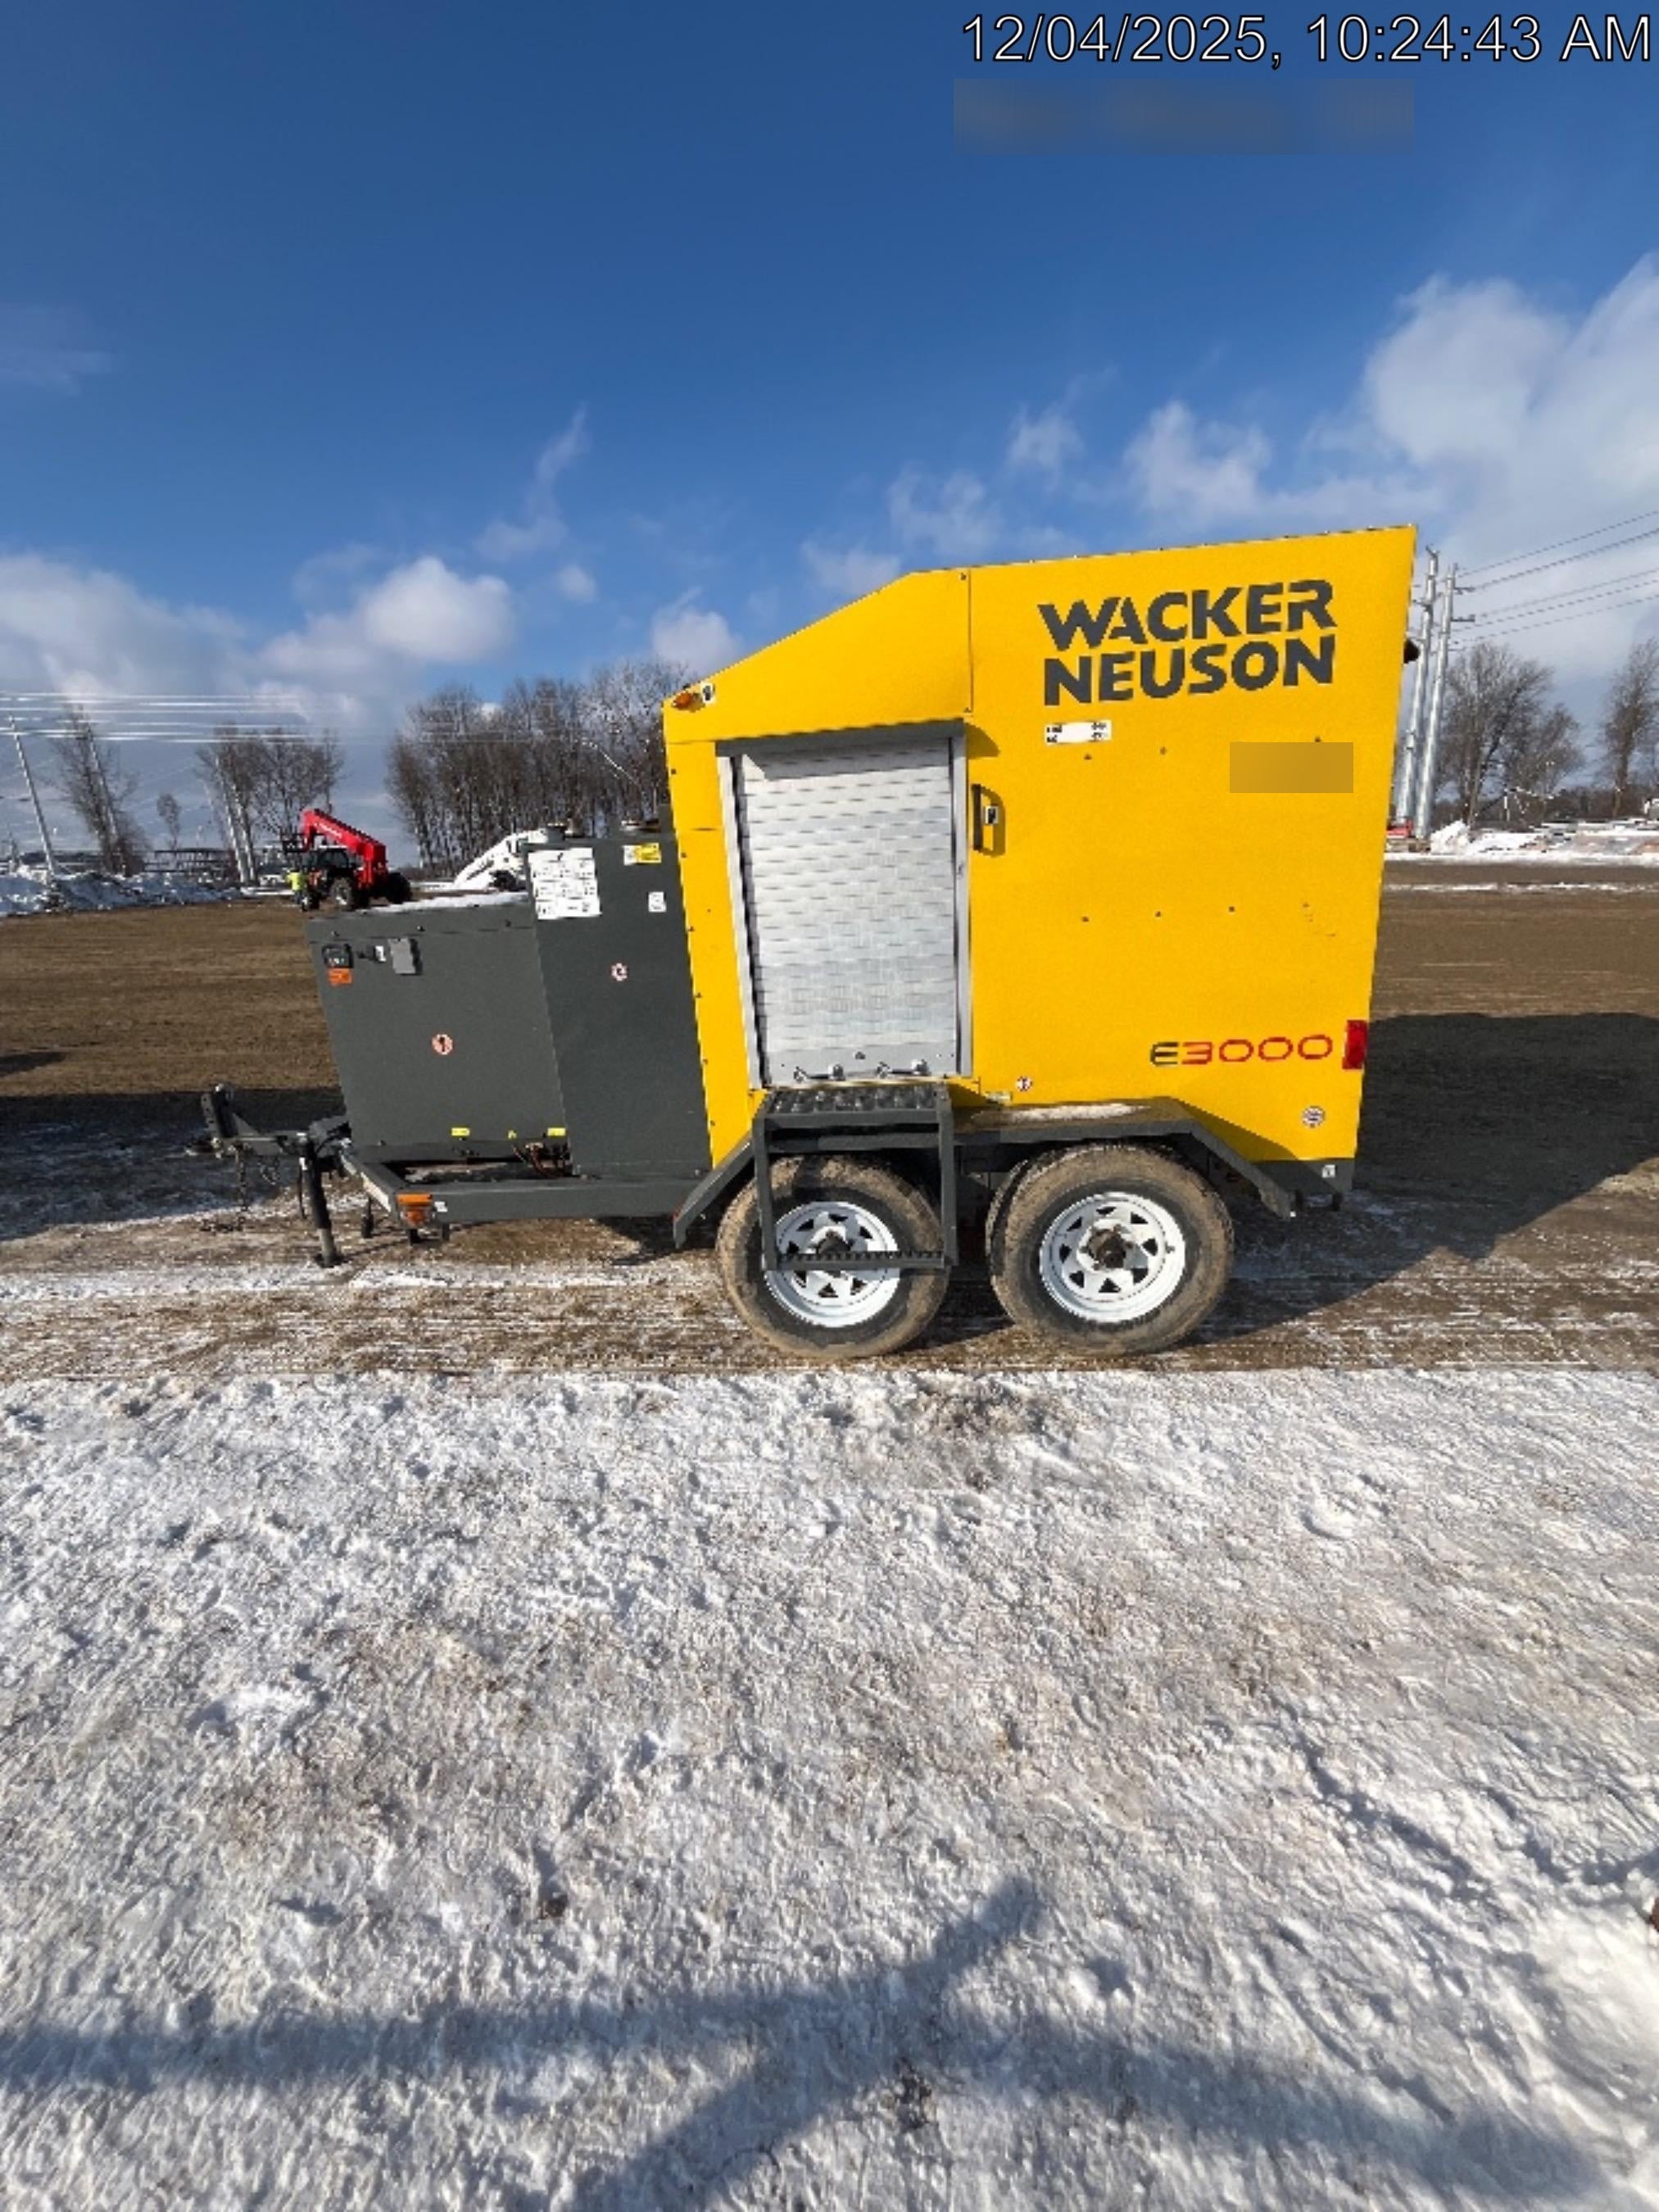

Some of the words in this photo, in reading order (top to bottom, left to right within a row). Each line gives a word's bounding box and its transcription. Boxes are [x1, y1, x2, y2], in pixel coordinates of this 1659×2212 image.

[1037, 579, 1336, 651] WACKER
[1044, 636, 1335, 706] NEUSON
[1149, 1033, 1334, 1067] E3000
